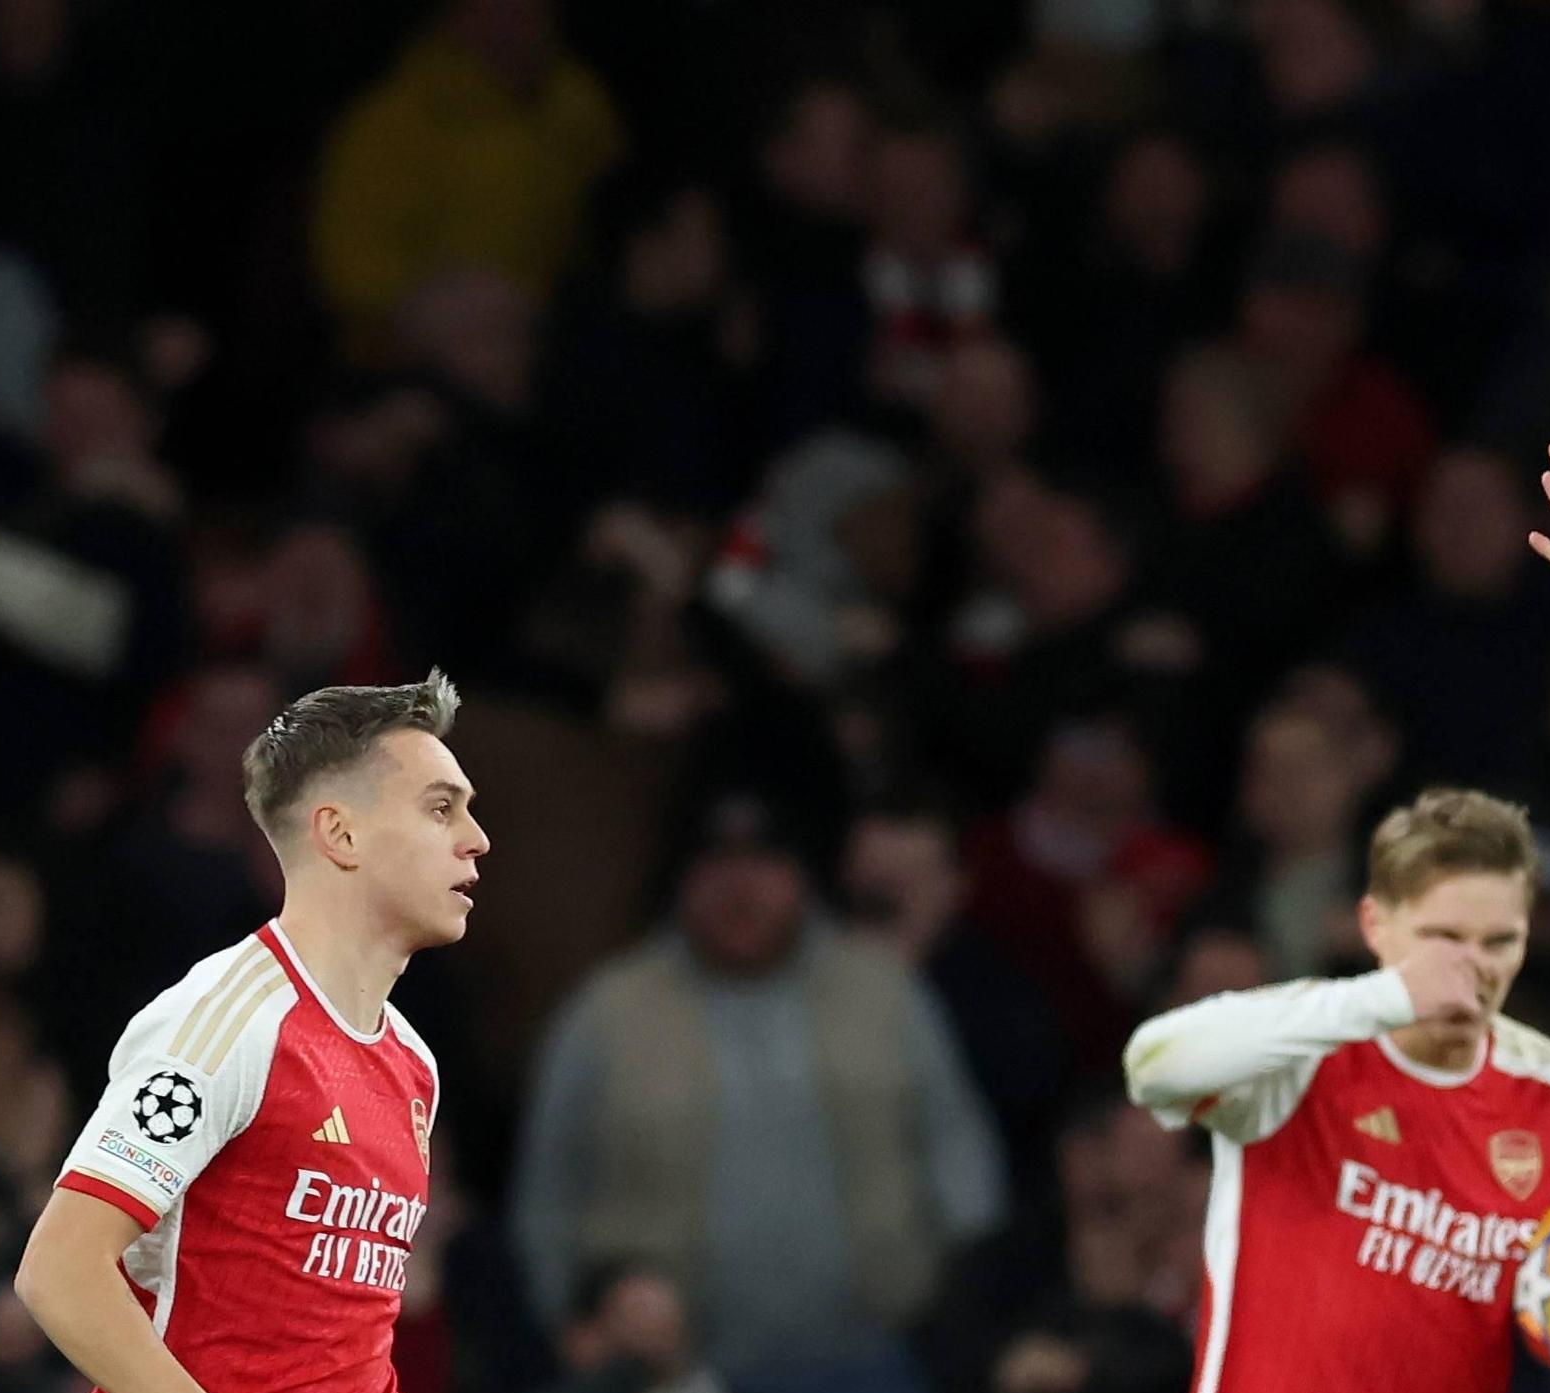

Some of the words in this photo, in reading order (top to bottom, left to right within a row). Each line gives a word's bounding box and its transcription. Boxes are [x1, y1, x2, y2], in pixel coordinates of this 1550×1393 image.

[98, 1135, 182, 1189] FOUNDATION
[1336, 1158, 1540, 1261] Emirates
[302, 1232, 351, 1279] FLY
